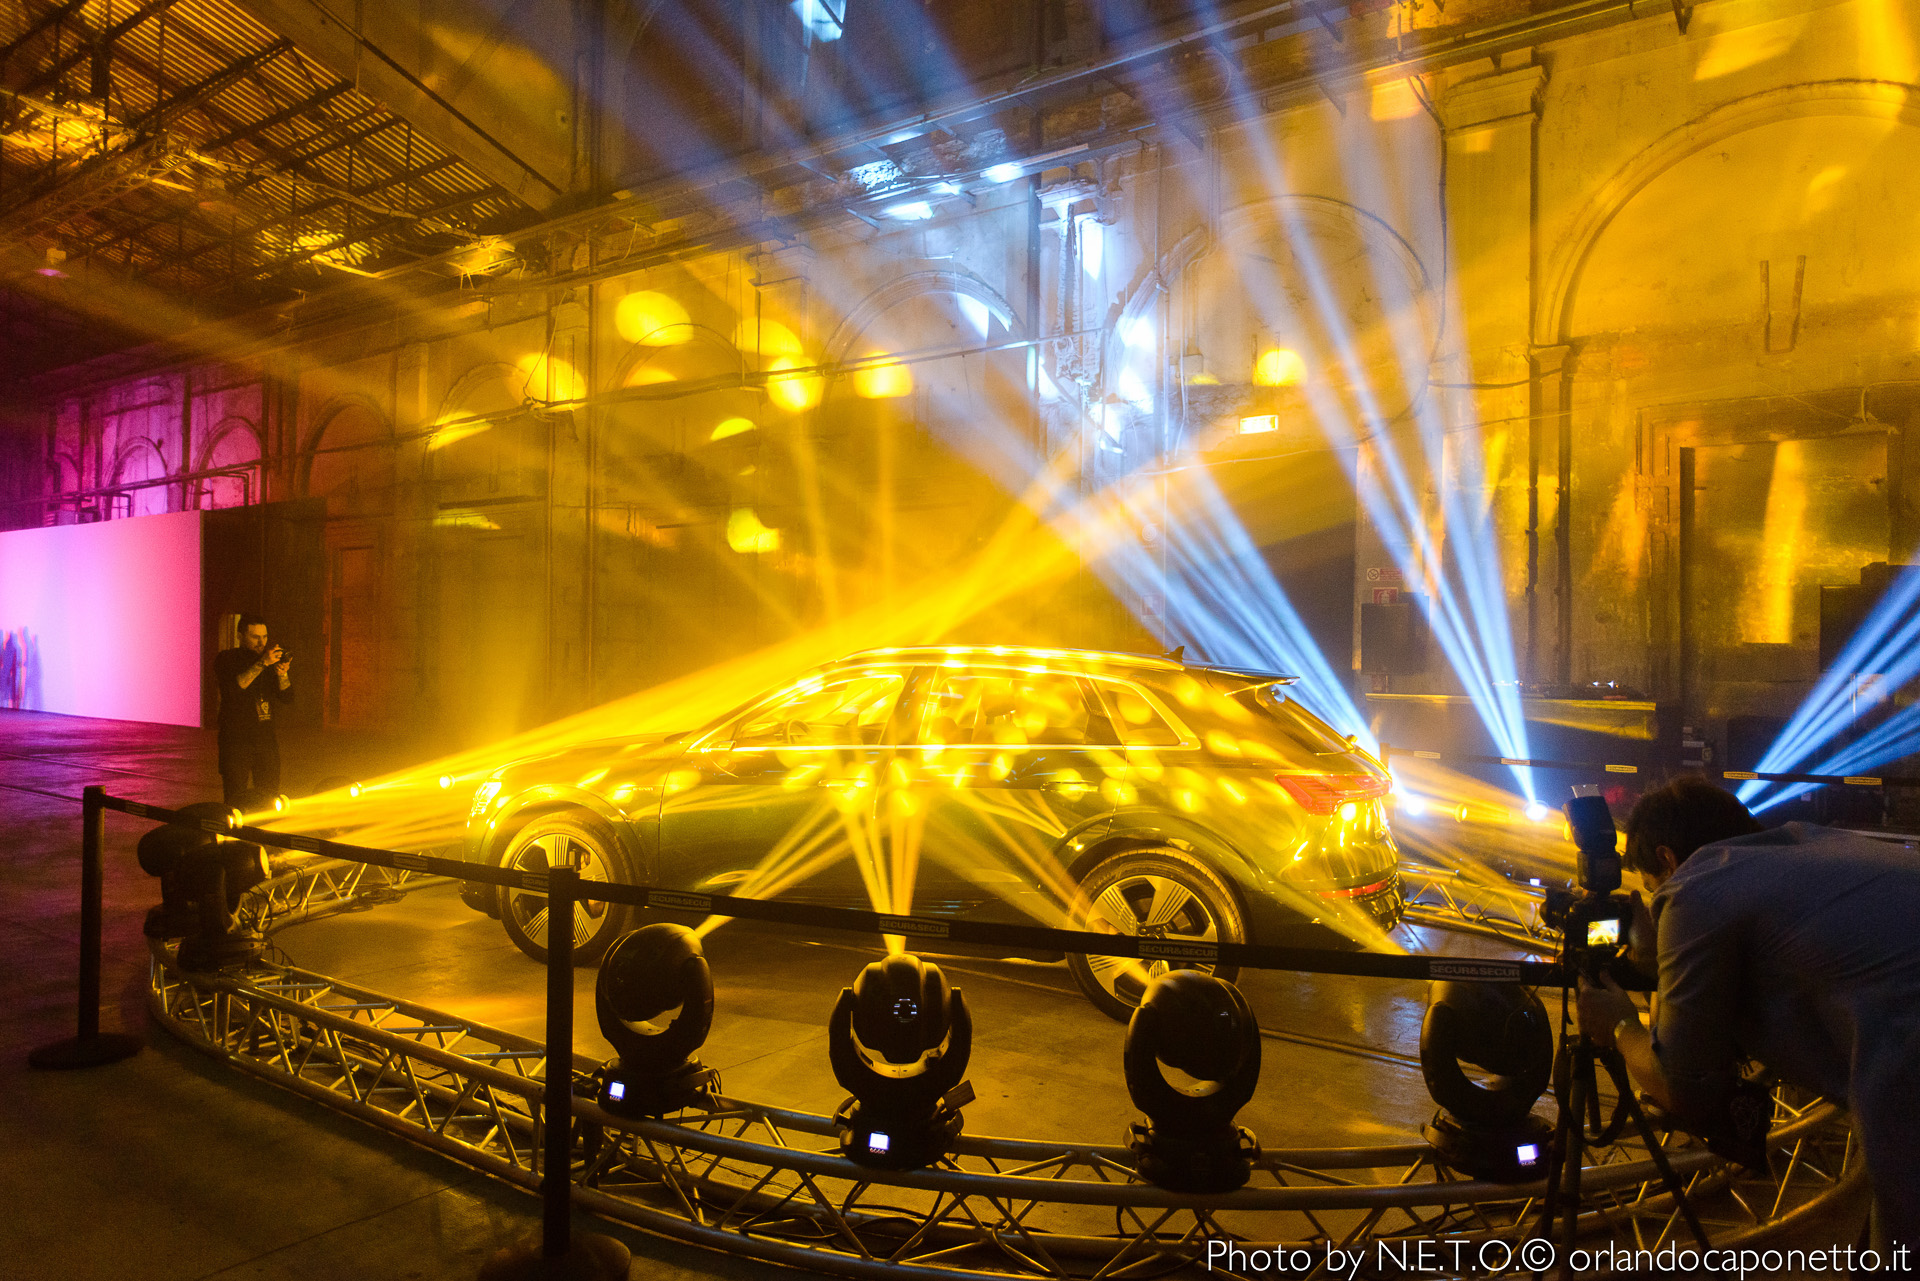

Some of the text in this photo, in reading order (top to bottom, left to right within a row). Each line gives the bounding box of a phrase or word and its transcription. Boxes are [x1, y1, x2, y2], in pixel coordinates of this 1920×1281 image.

[879, 919, 950, 934] SECUR&SECUR
[1138, 944, 1218, 957] SECUR&SECUR
[1429, 964, 1520, 977] SECUR&SECUR
